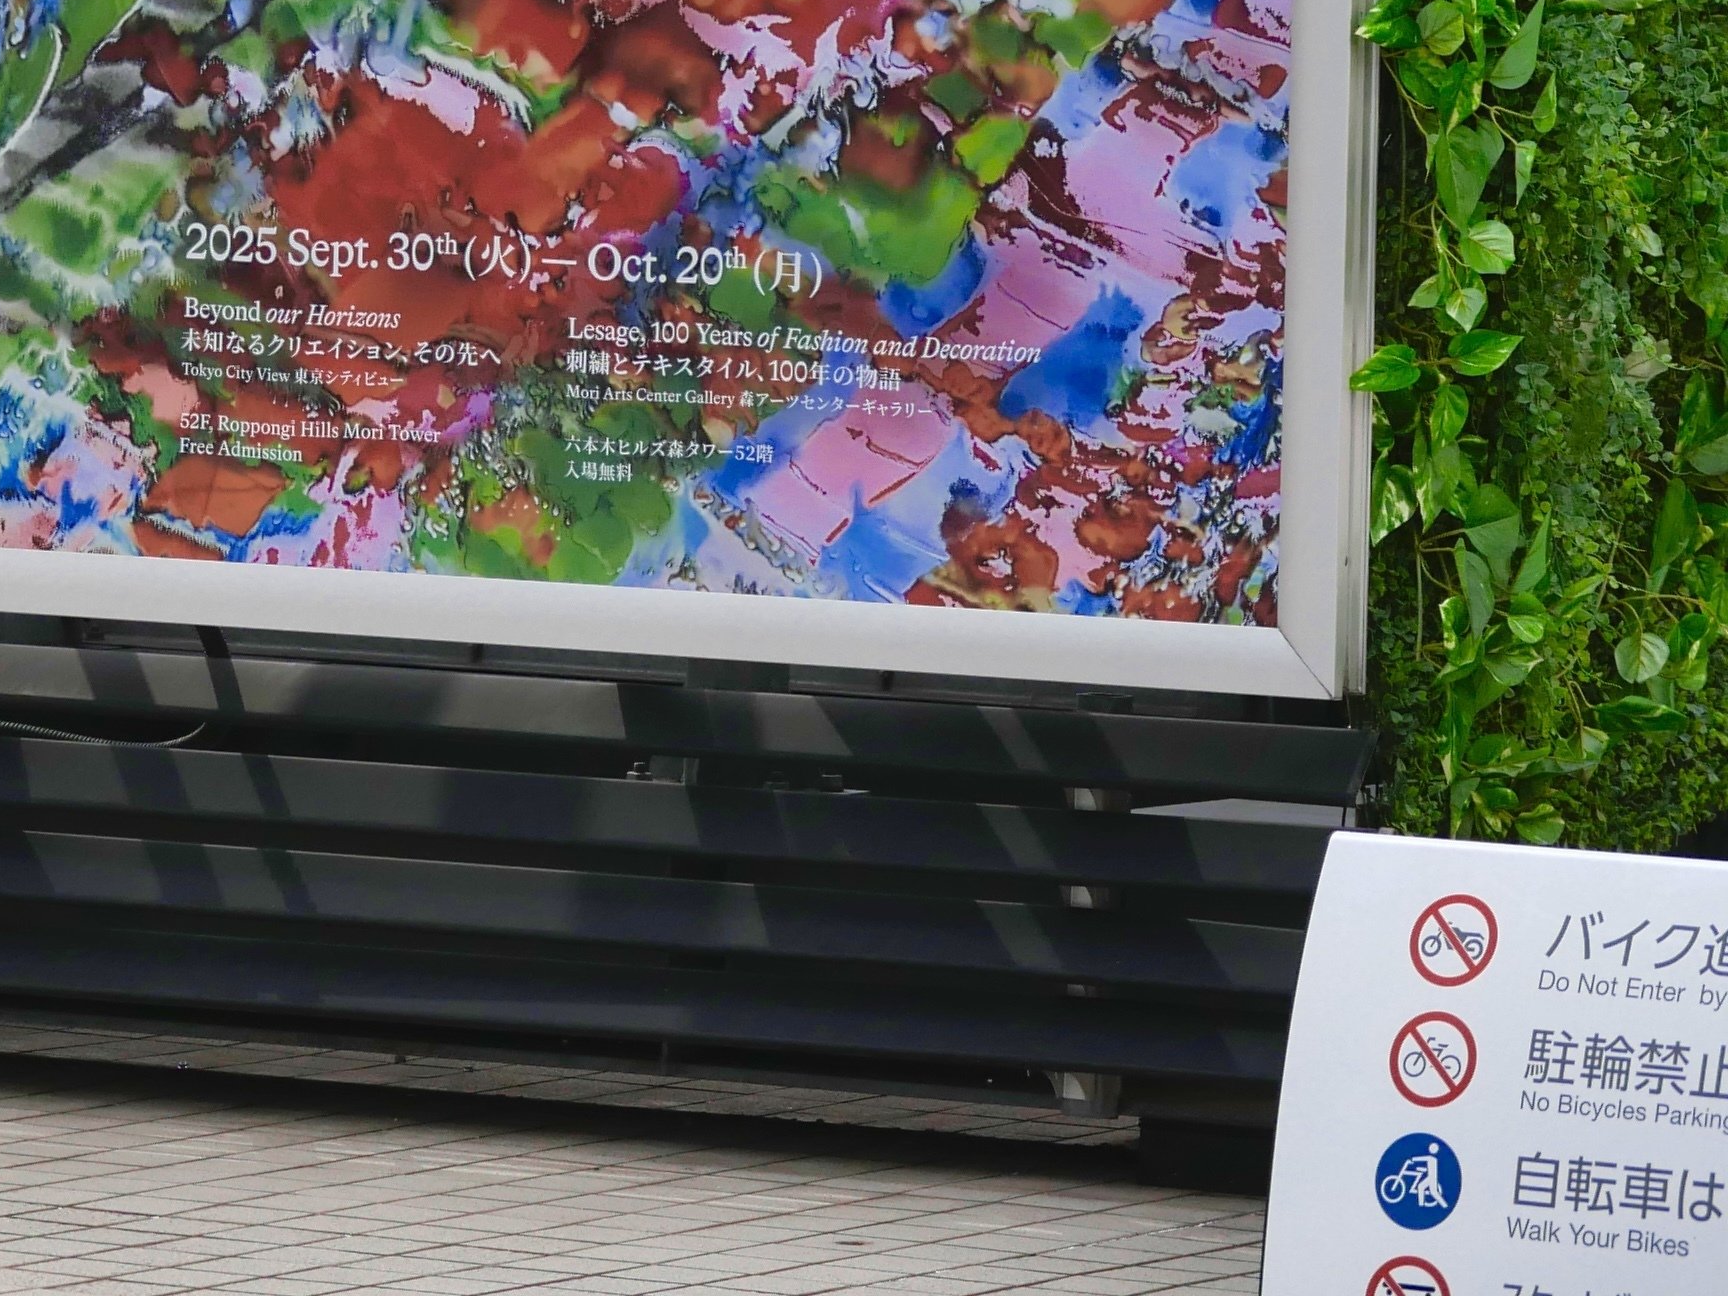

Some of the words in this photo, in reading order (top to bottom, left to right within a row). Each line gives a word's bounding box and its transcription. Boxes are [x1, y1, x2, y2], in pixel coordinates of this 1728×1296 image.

[184, 296, 261, 325] Beyond
[265, 307, 303, 324] our
[305, 304, 402, 329] Horizons
[182, 327, 501, 368] 未知なるクリエイション、その先へ
[568, 317, 646, 348] Lesage,
[650, 321, 690, 344] 100
[695, 322, 753, 348] Years
[756, 325, 782, 354] of
[782, 327, 868, 354] Fashion
[872, 334, 918, 356] and
[920, 335, 1042, 362] Decoration
[566, 349, 901, 390] 刺繍とテキスタイル、100年の物語
[1538, 969, 1570, 992] Do
[1577, 973, 1619, 998] Not
[1625, 977, 1687, 1003] Enter
[1699, 983, 1728, 1012] by
[1524, 1028, 1728, 1100] 駐輪禁止
[1520, 1090, 1550, 1112] No
[1558, 1094, 1647, 1122] Bicycles
[1513, 1151, 1726, 1222] 自転車は
[1506, 1216, 1560, 1243] Walk
[1569, 1223, 1620, 1250] Your
[1627, 1229, 1690, 1258] Bikes
